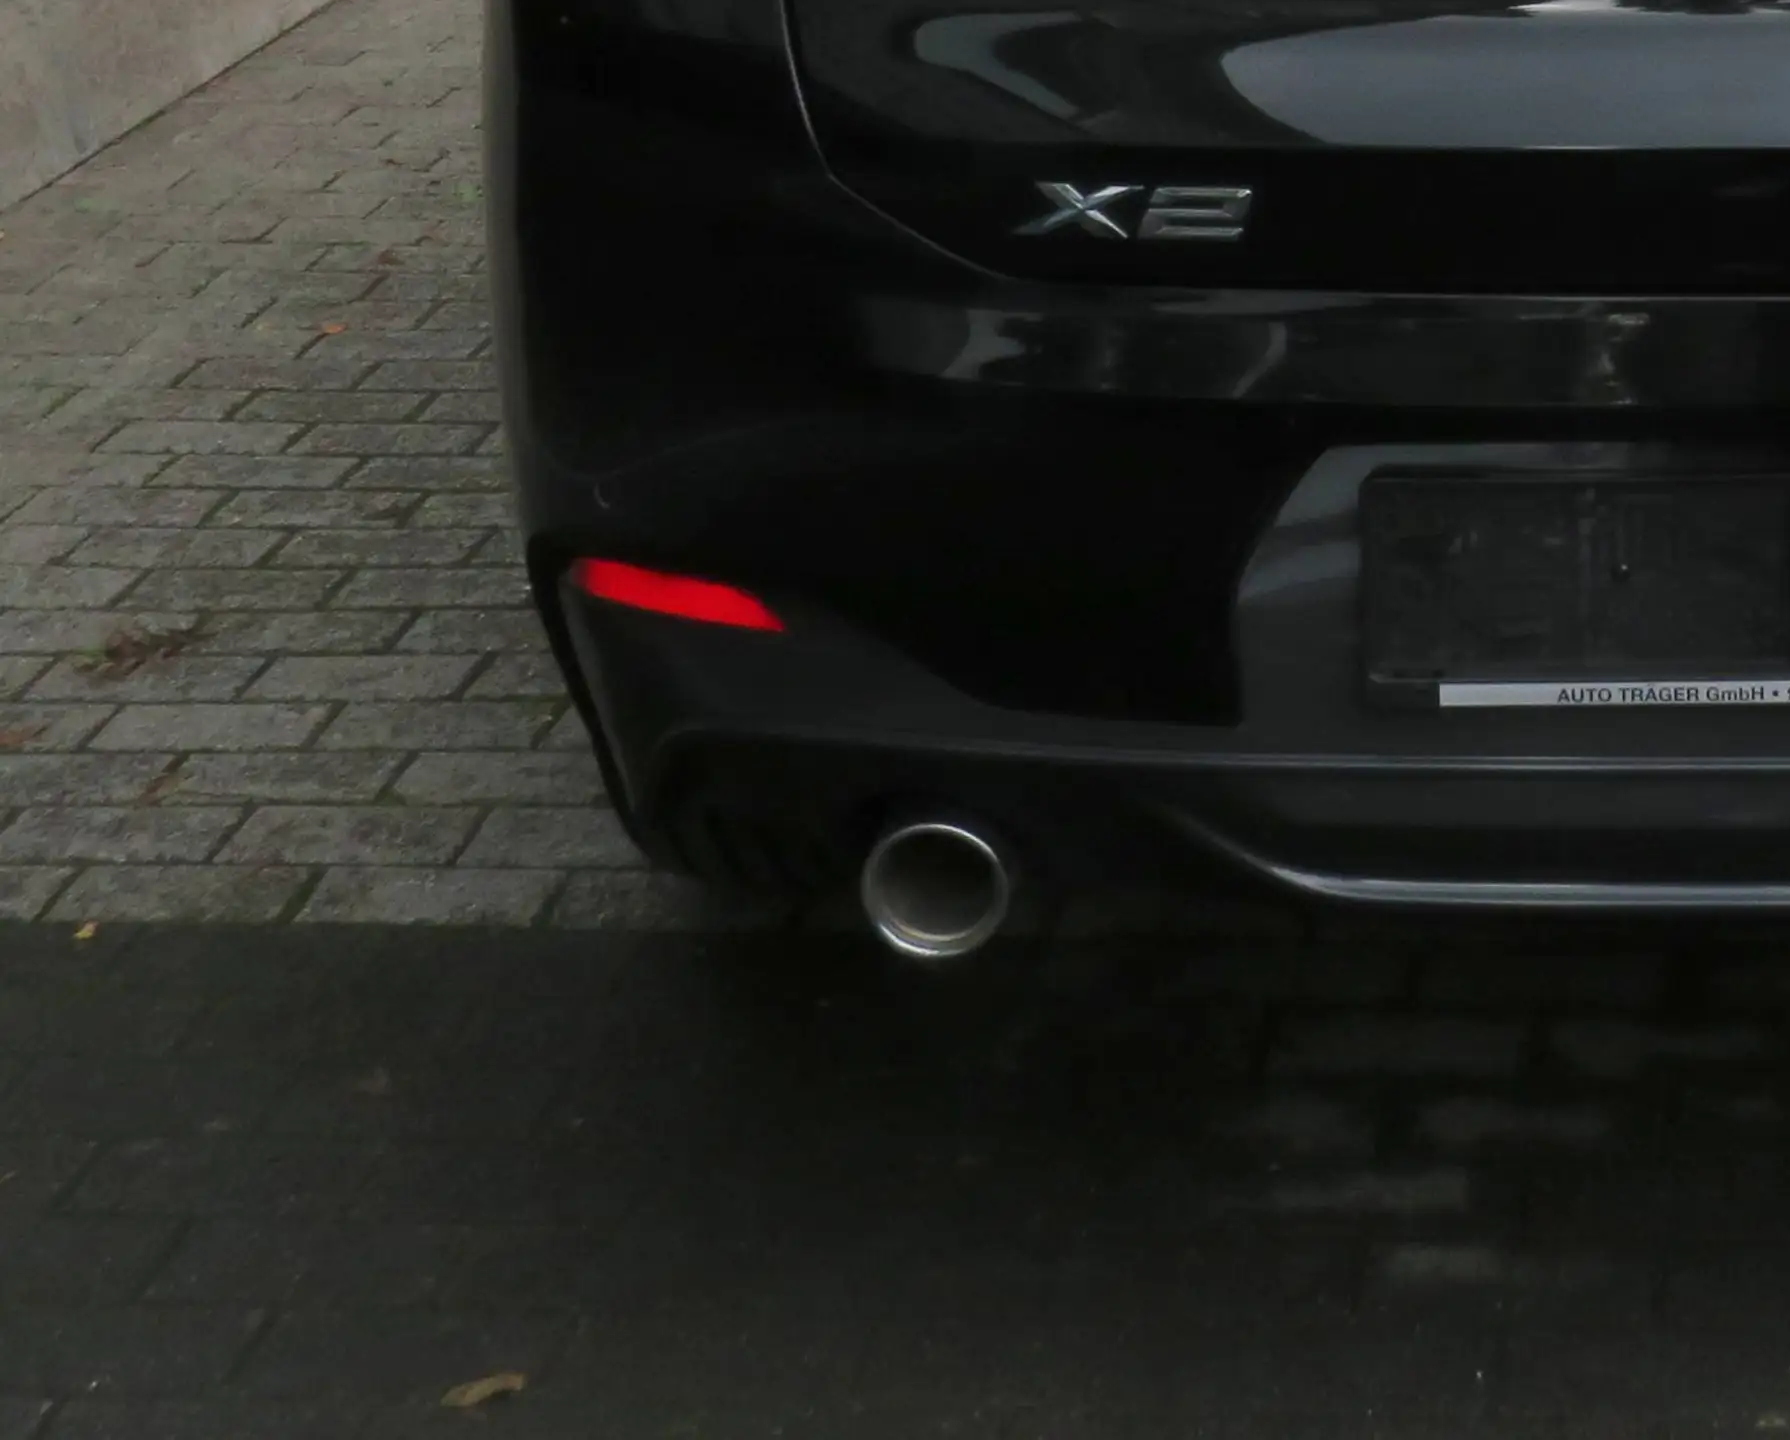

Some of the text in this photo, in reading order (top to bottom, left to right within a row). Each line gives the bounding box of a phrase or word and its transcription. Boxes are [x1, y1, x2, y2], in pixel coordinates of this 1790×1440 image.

[1010, 179, 1254, 242] X2
[1556, 686, 1613, 704] AUTO
[1618, 683, 1700, 703] TRÄGER
[1705, 685, 1766, 702] GmbH
